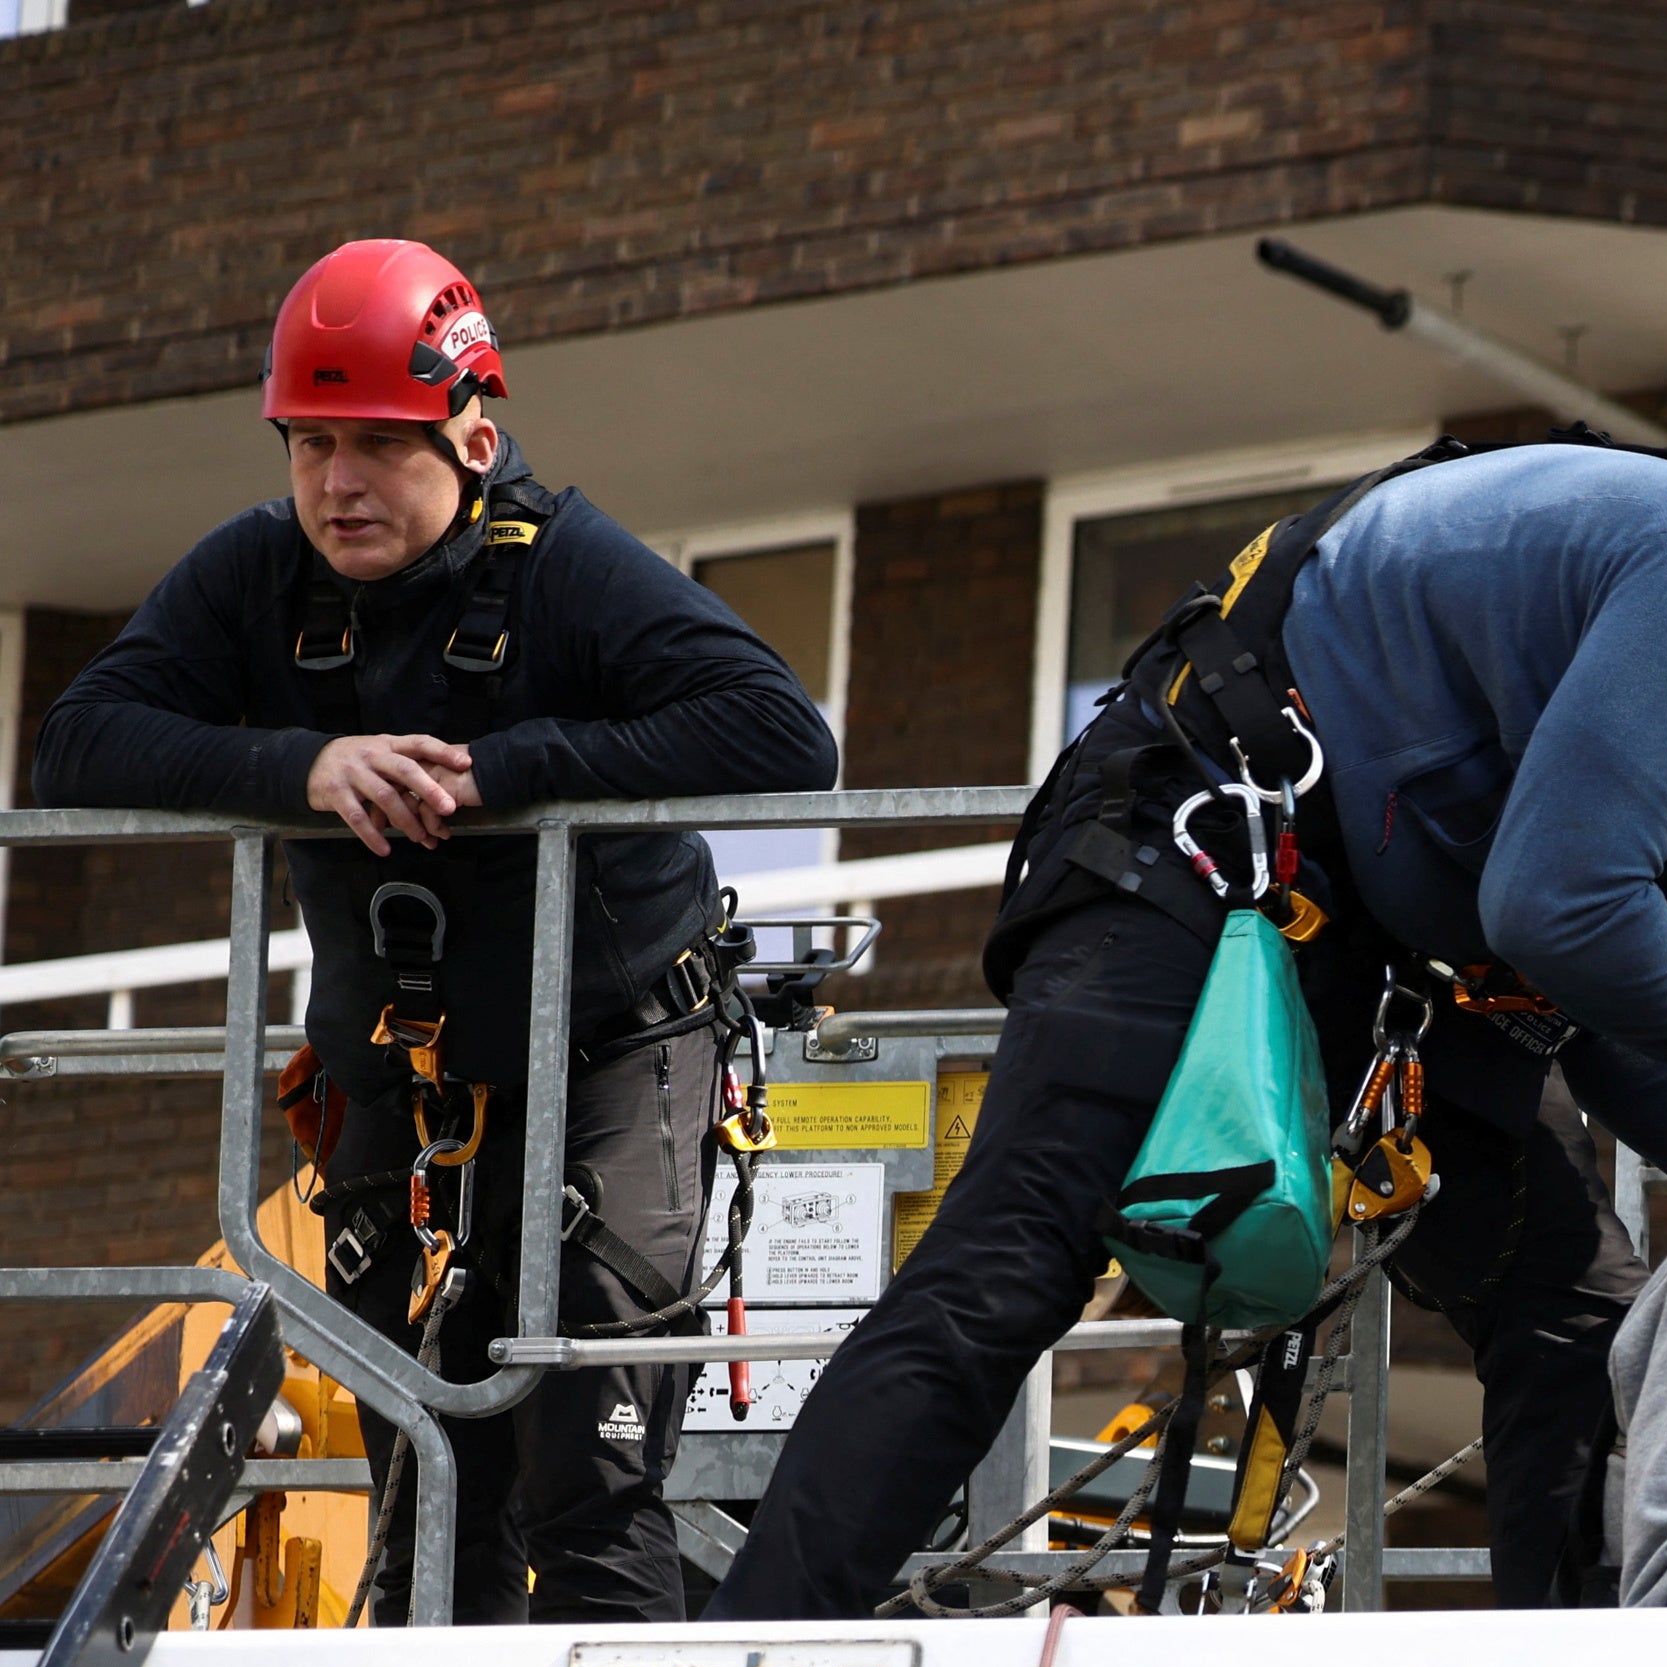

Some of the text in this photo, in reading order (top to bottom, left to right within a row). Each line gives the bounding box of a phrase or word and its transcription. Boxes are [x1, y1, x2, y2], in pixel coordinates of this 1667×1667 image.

[491, 526, 526, 542] PETZL
[819, 1115, 853, 1123] OPERATION
[1284, 1331, 1303, 1370] PETZL
[598, 1422, 646, 1435] MOUNTAIN
